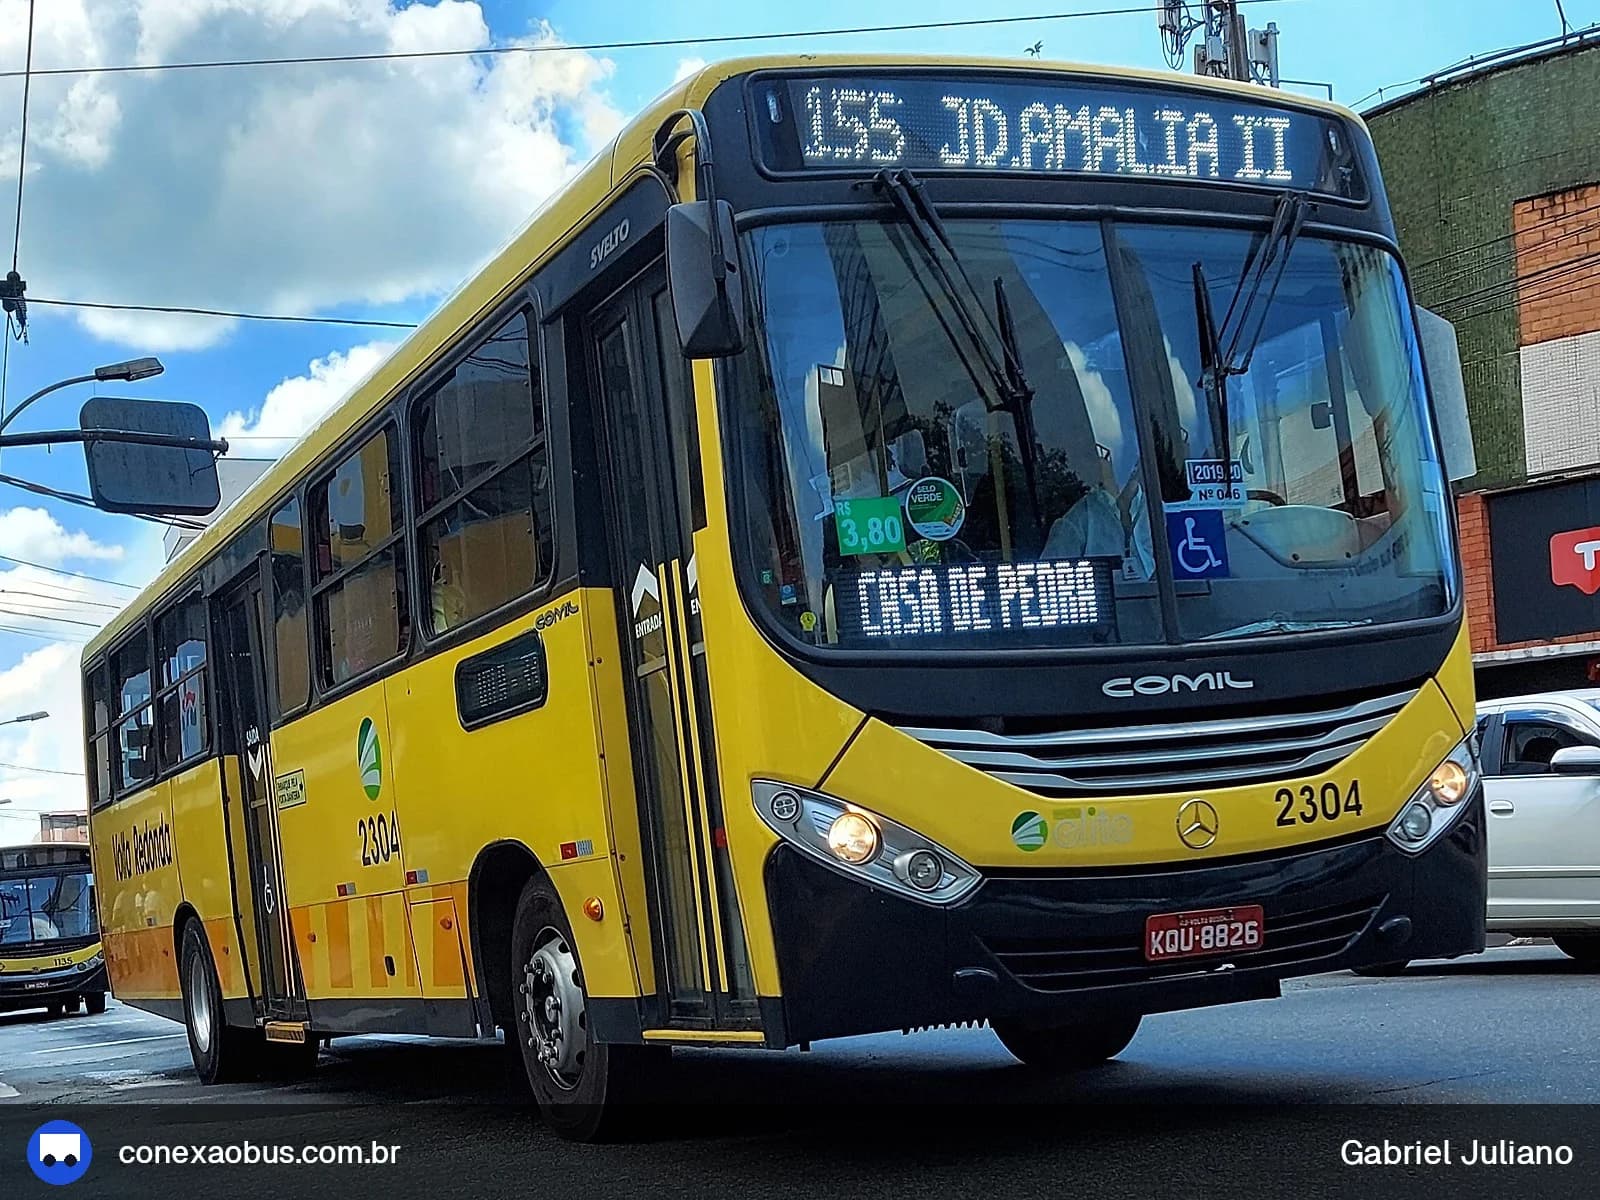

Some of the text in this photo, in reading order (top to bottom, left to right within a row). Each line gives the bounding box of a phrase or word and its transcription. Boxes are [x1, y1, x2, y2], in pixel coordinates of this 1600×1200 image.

[804, 86, 903, 162] 155
[1233, 114, 1293, 181] II
[590, 218, 630, 269] SVELTO
[911, 492, 943, 503] VERDE
[841, 516, 901, 552] 3,80
[535, 600, 579, 631] COMIL
[858, 560, 1099, 636] CASA DE PEDRA
[1102, 671, 1254, 698] COMIL
[1274, 779, 1364, 828] 2304
[133, 811, 173, 876] Redonda
[358, 810, 401, 866] 2304
